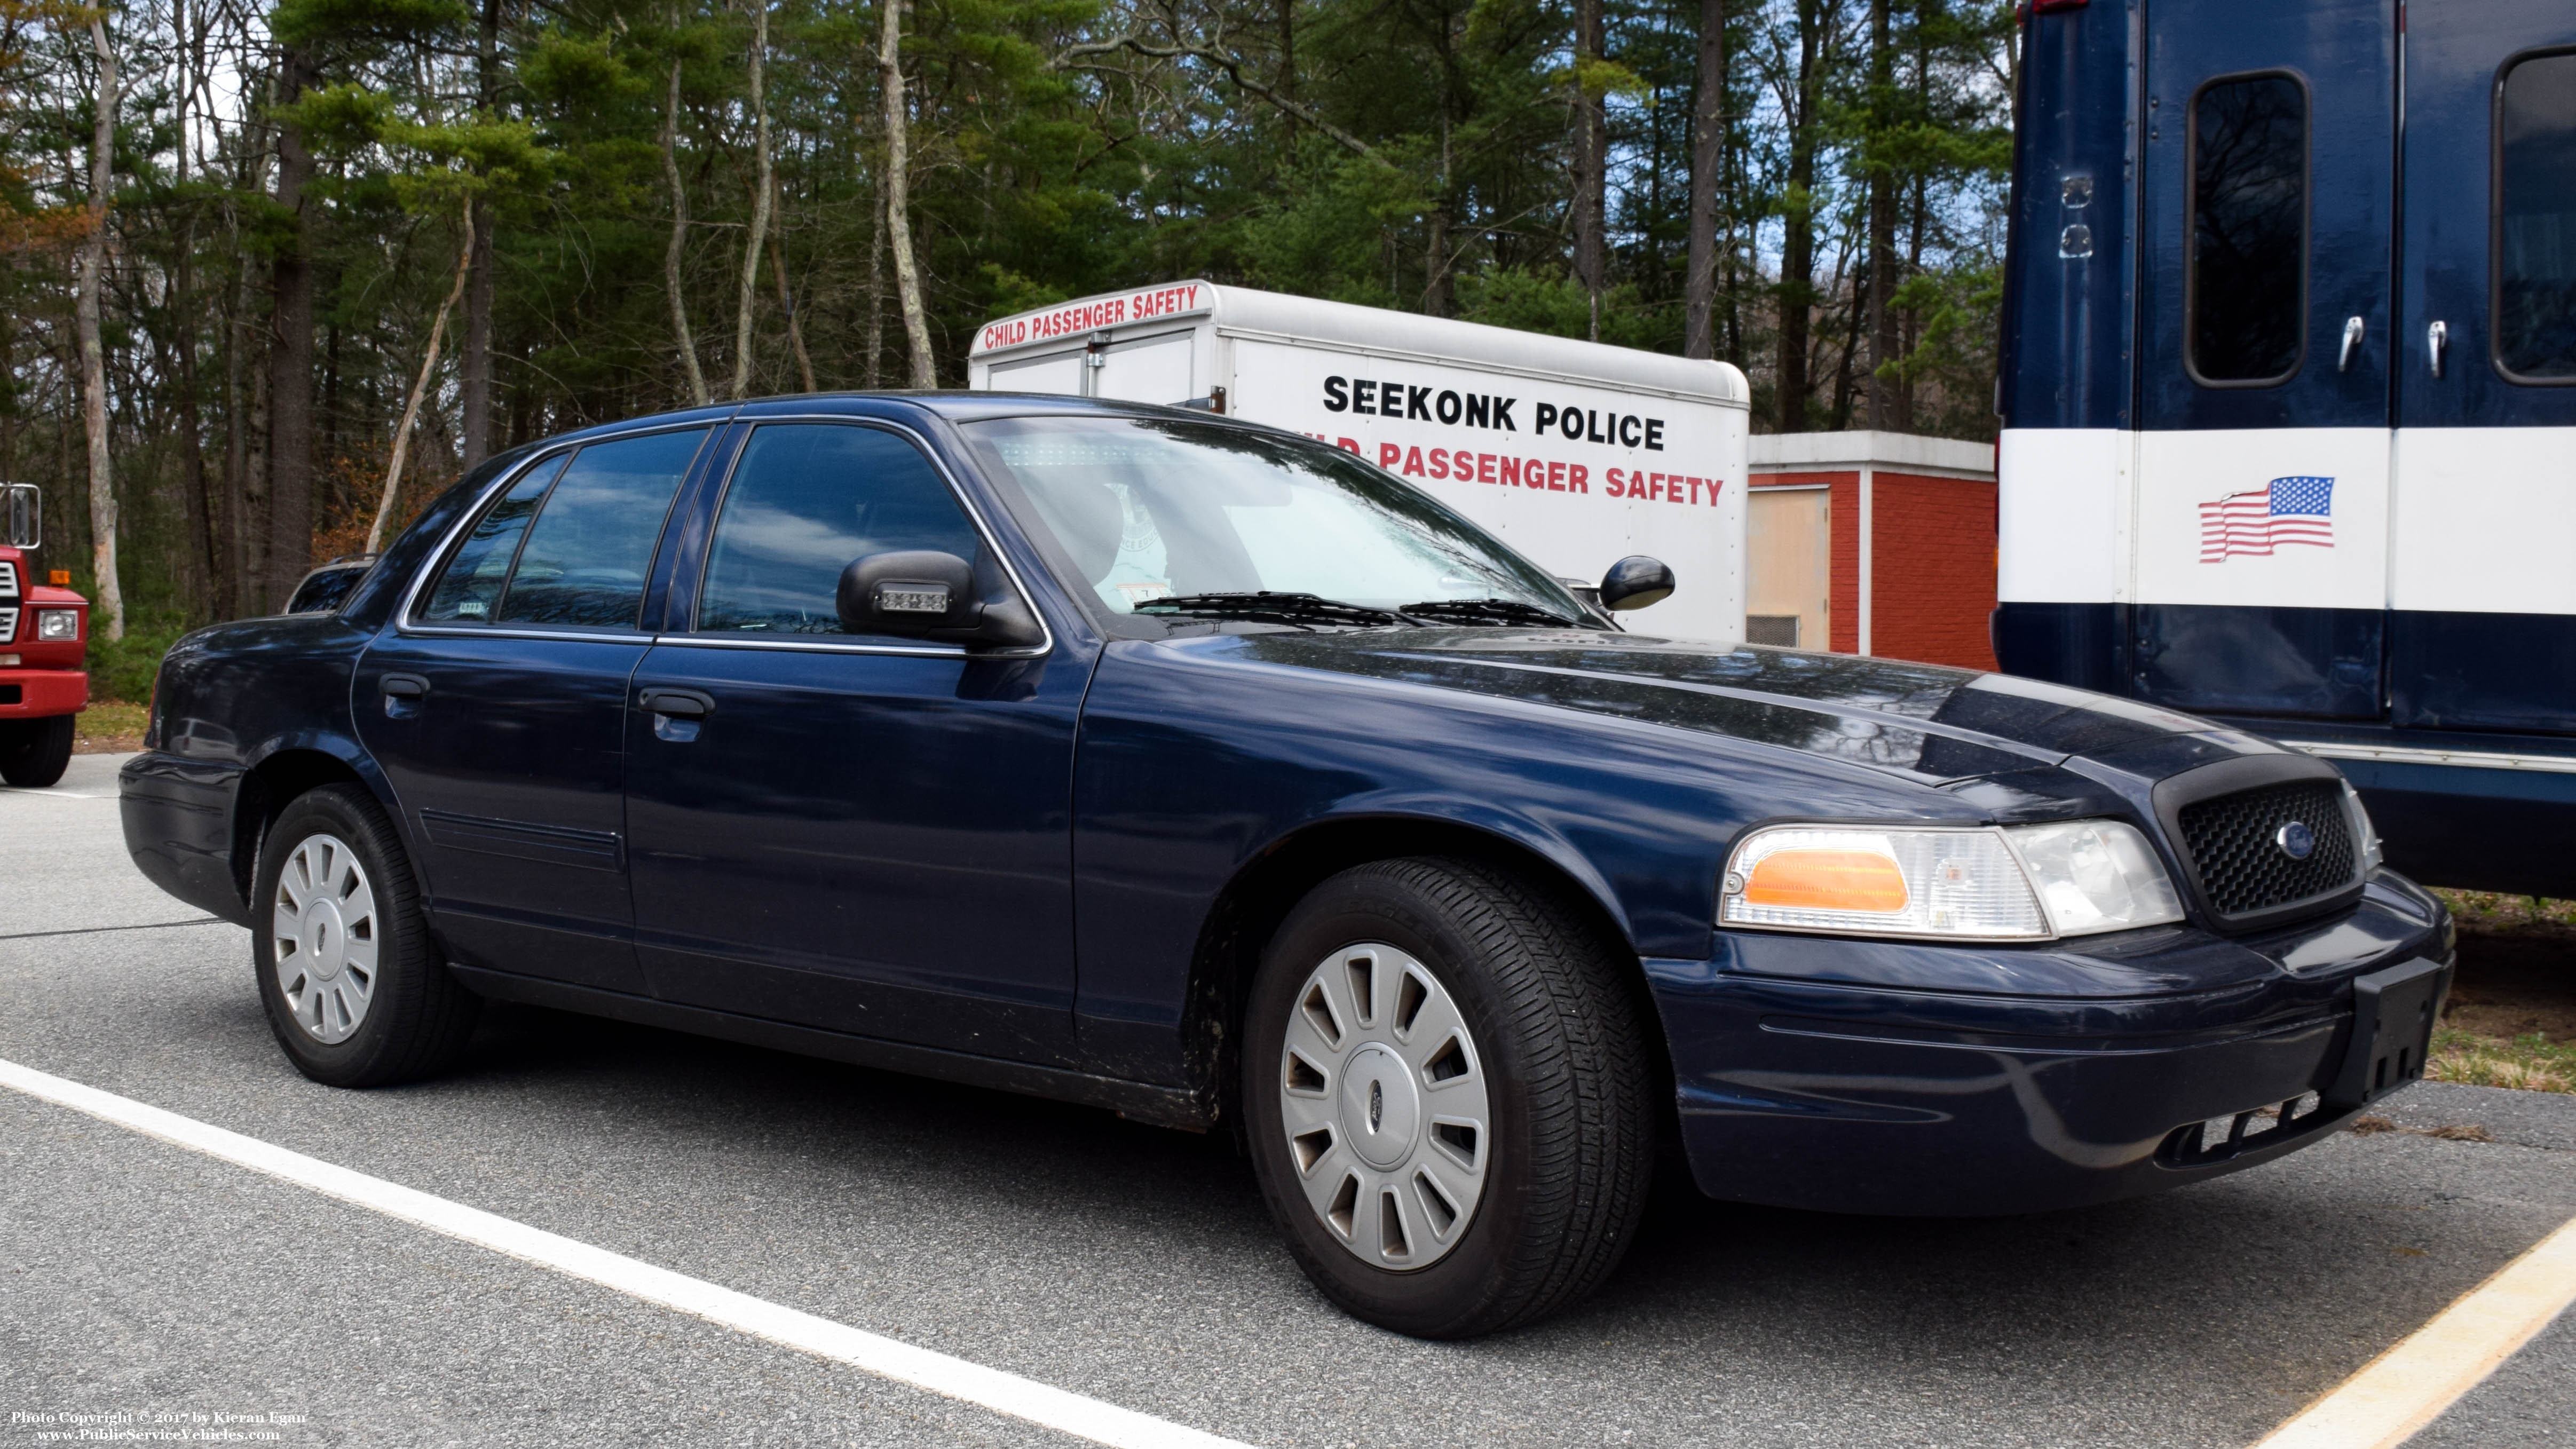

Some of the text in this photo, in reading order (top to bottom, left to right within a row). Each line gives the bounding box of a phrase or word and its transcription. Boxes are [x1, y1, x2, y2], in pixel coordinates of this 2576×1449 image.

[985, 286, 1197, 349] CHILD PASSENGER SAFETY
[1323, 376, 1664, 451] SEEKONK POLICE
[1380, 442, 1589, 494] PASSENGER
[1606, 468, 1723, 506] SAFETY
